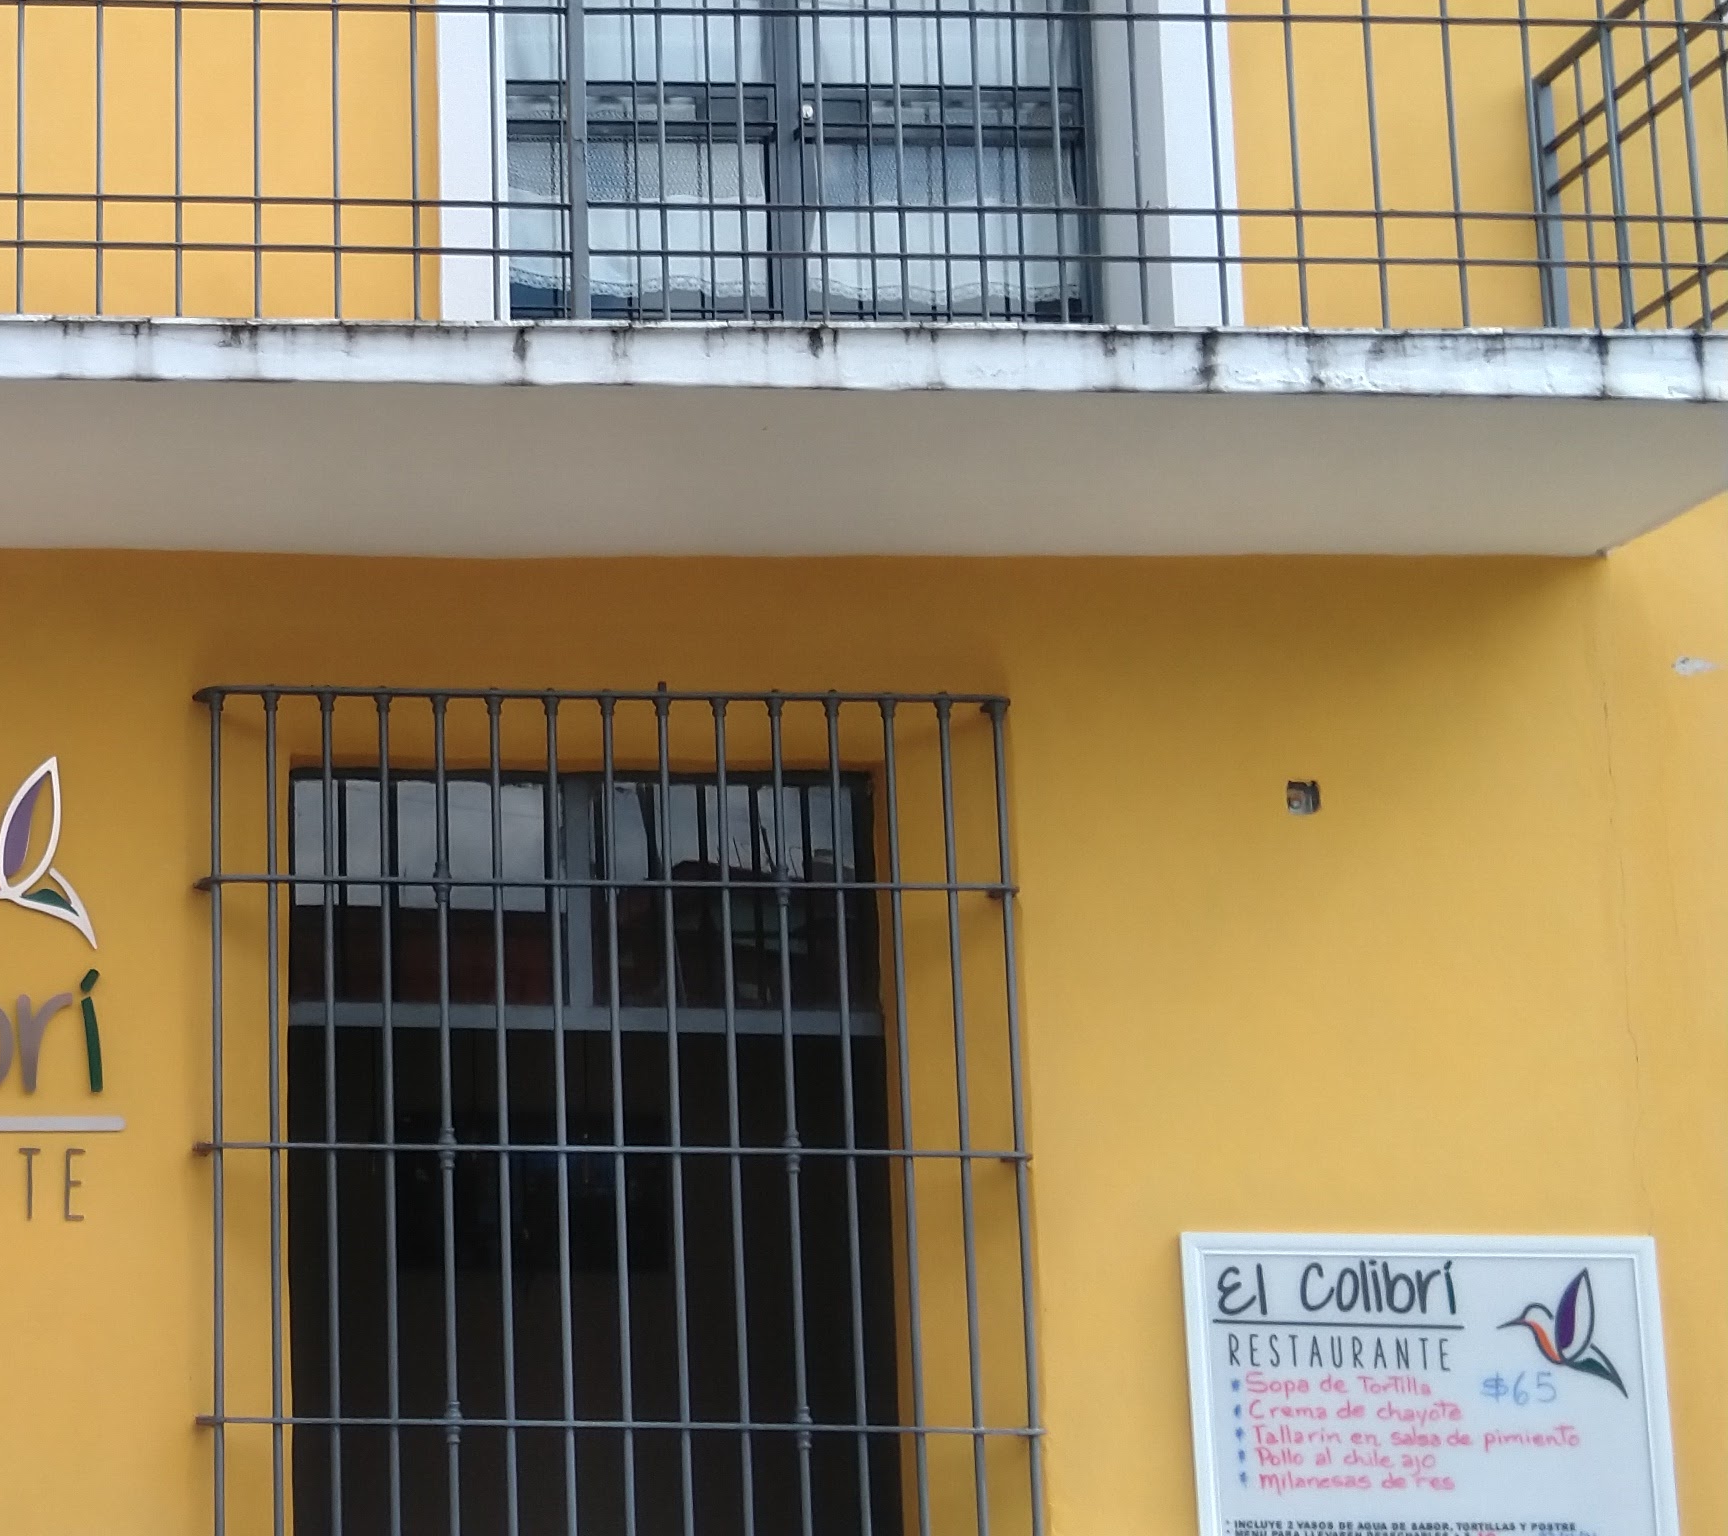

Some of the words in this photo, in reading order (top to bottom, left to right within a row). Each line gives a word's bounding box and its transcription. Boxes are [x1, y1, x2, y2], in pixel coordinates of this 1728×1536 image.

[1217, 1262, 1268, 1315] El
[1300, 1259, 1457, 1315] Colibrí
[1228, 1333, 1451, 1371] RESTAURANTE
[1245, 1371, 1310, 1400] Sopa
[1320, 1373, 1349, 1393] de
[1480, 1371, 1558, 1407] $65
[1249, 1399, 1328, 1419] Crema
[1336, 1399, 1365, 1419] de
[1350, 1432, 1381, 1446] en
[1390, 1426, 1442, 1446] salsa
[1446, 1427, 1472, 1446] de
[1483, 1425, 1580, 1453] pimiento
[1254, 1447, 1304, 1467] Pollo
[1315, 1447, 1332, 1466] al
[1343, 1448, 1393, 1468] chile
[1401, 1453, 1436, 1478] ajo
[1381, 1472, 1407, 1490] de
[1414, 1476, 1456, 1491] res
[1234, 1520, 1283, 1530] INCLUYE
[1297, 1521, 1334, 1530] VASOS
[1339, 1521, 1353, 1531] DE
[1357, 1522, 1388, 1531] AGUA
[1392, 1522, 1406, 1531] DE
[1456, 1522, 1516, 1532] TORTILLAS
[1520, 1522, 1527, 1532] Y
[1531, 1522, 1576, 1532] POSTRE
